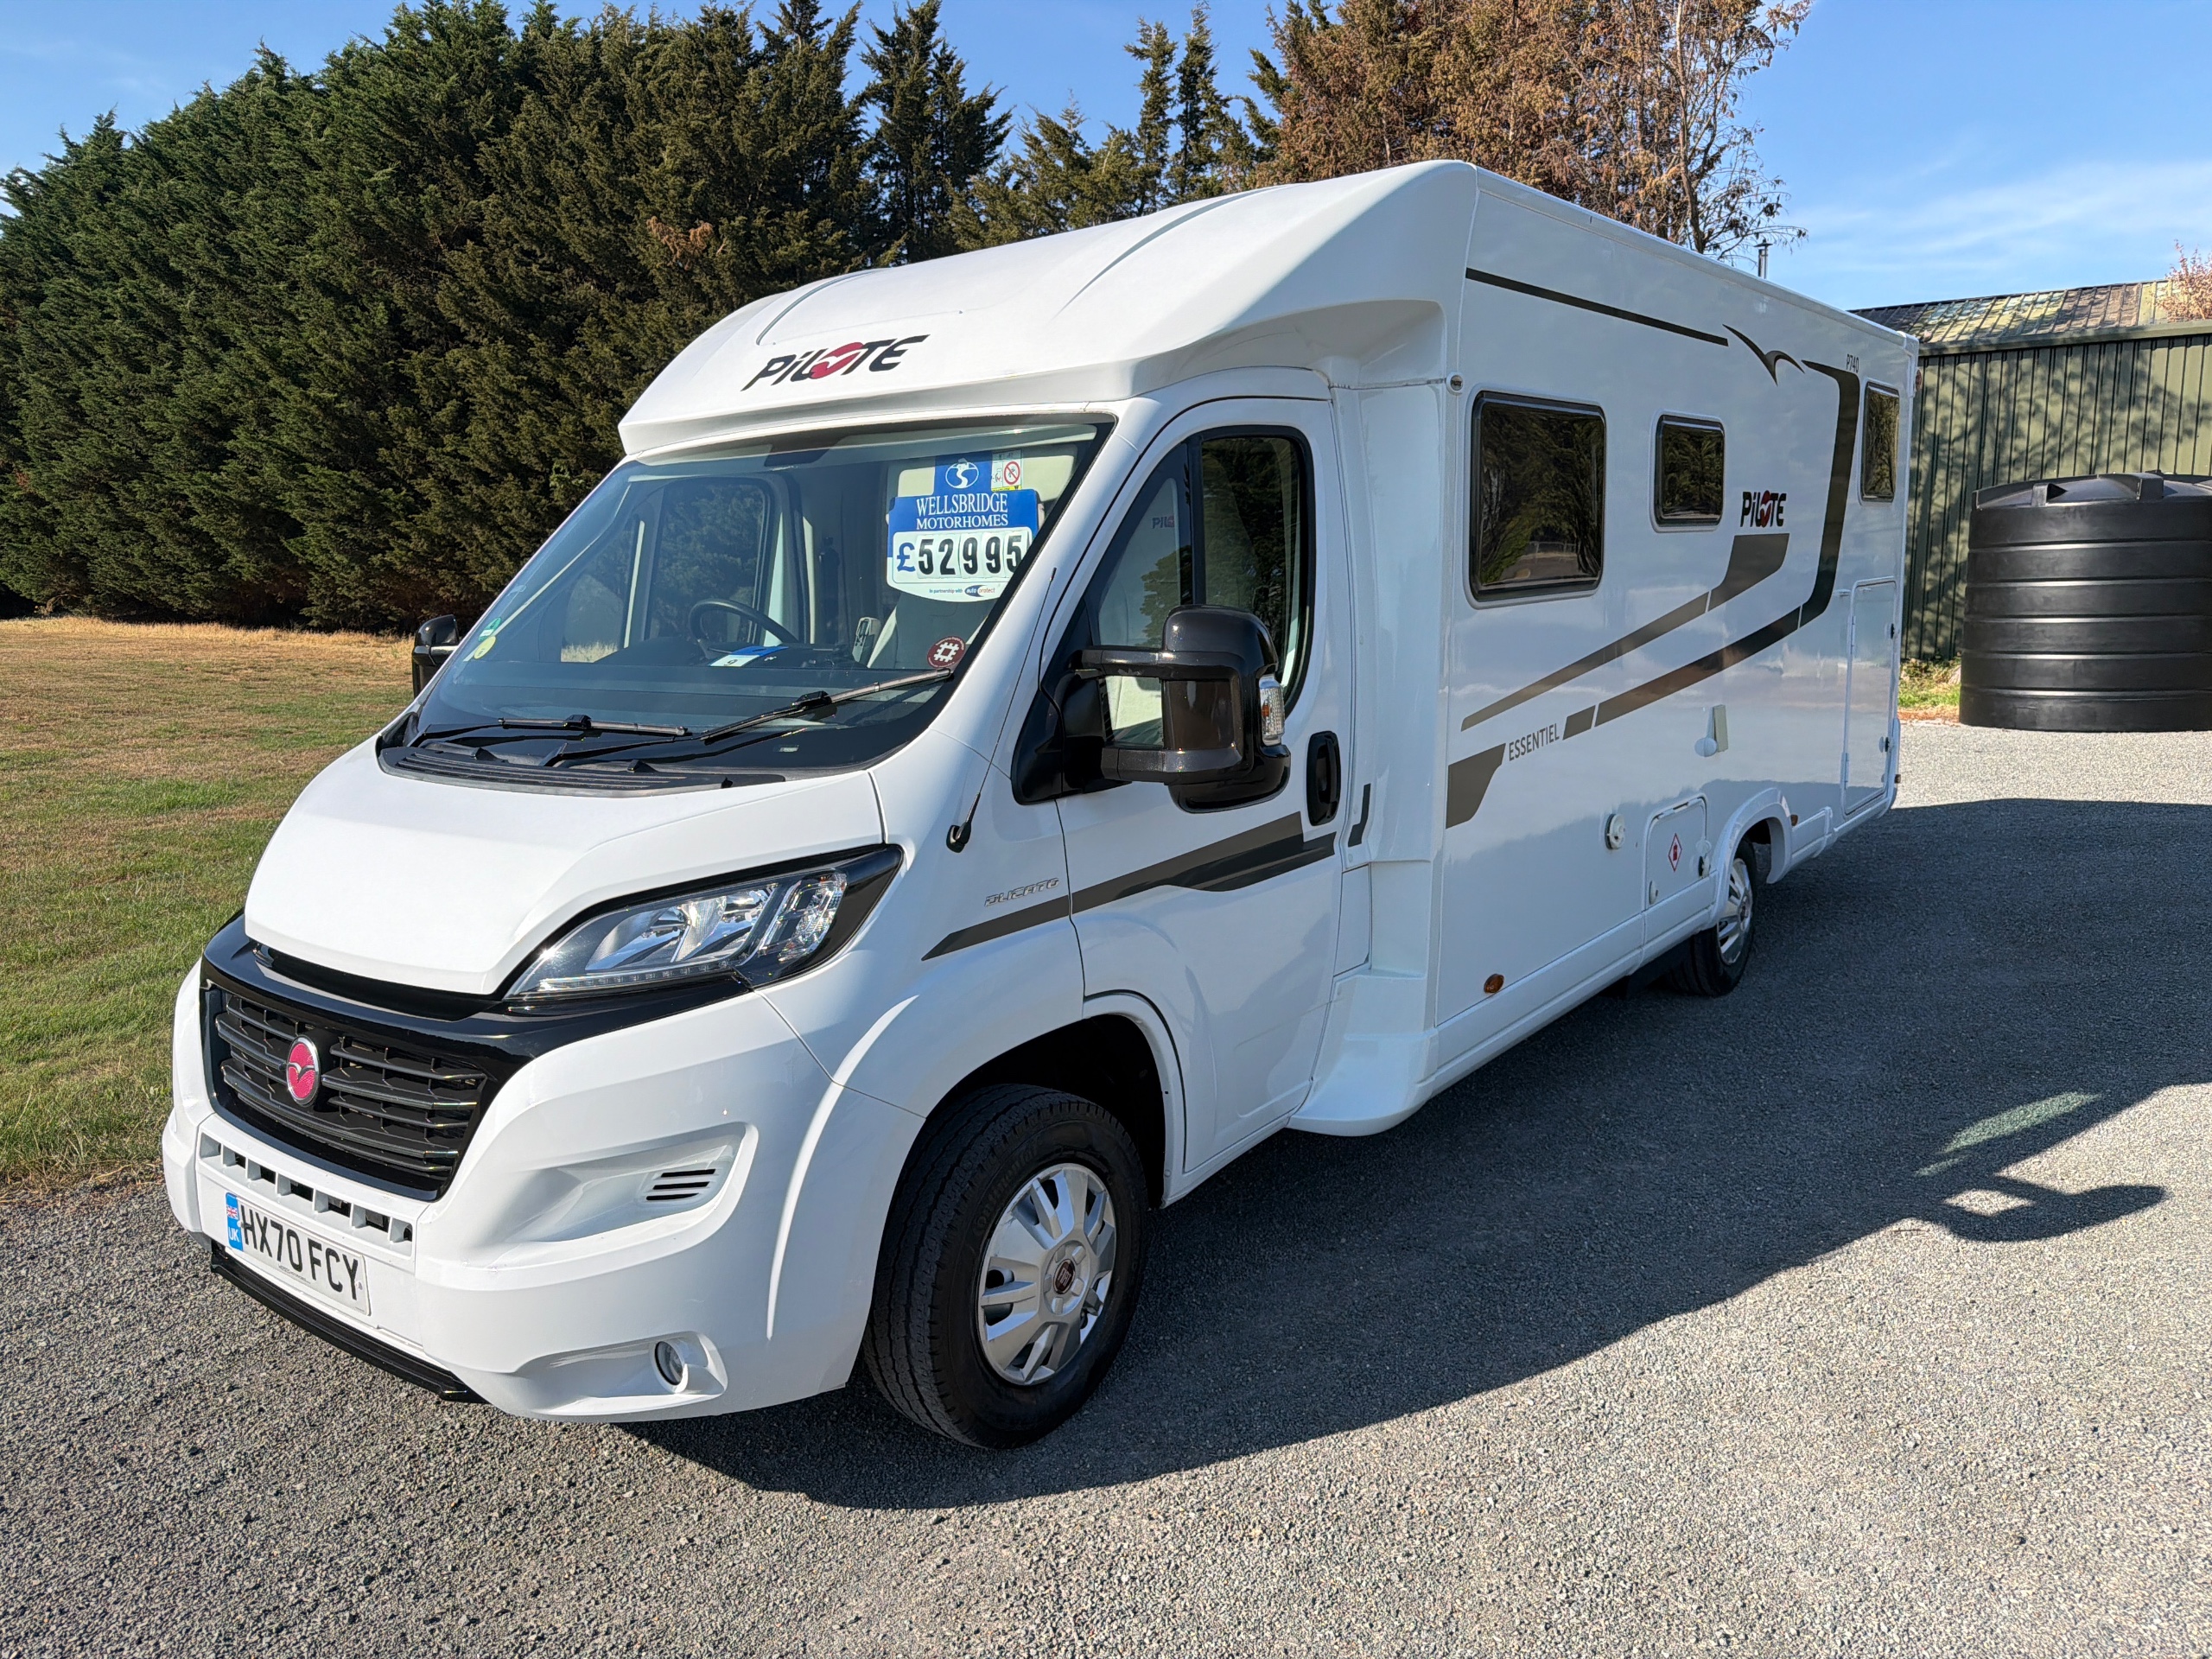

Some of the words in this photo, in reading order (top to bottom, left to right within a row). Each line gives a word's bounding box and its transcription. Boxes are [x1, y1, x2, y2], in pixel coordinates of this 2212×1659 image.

[1846, 353, 1859, 373] P740
[916, 493, 1008, 517] WELLSBRIDGE
[916, 514, 1008, 530] MOTORHOMES
[896, 534, 1022, 575] £52995
[1509, 723, 1560, 761] ESSENTIEL
[984, 878, 1059, 906] DUCATO
[228, 1227, 240, 1243] UK
[240, 1205, 302, 1272] HX70
[308, 1236, 359, 1300] FCY
